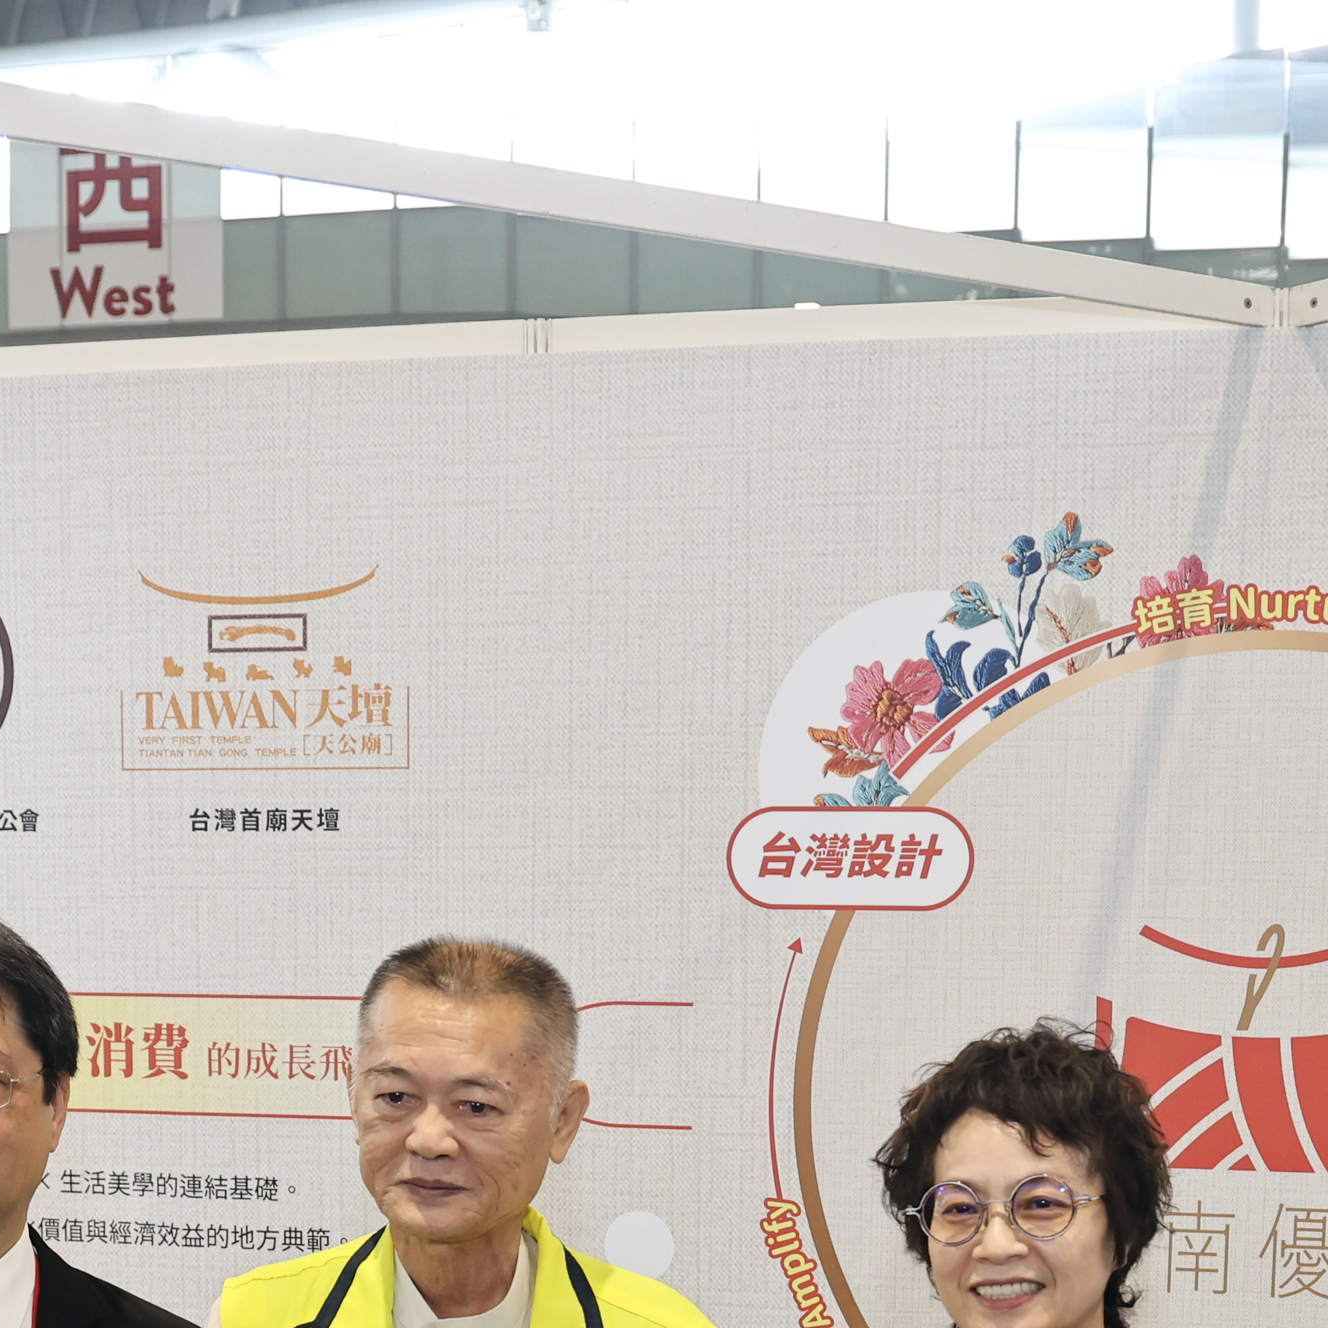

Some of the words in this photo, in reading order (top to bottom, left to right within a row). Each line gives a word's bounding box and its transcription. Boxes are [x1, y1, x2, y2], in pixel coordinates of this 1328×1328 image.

[58, 148, 162, 252] 西
[50, 265, 175, 319] West
[1134, 587, 1215, 636] 培育
[136, 689, 300, 730] TAIWAN
[304, 683, 393, 728] 天壇
[139, 736, 165, 745] VERY
[172, 736, 203, 745] FIRST
[211, 735, 252, 744] TEMPLE
[139, 748, 184, 757] TIANTAN
[188, 748, 212, 757] TIAN
[219, 748, 248, 757] GONG
[257, 748, 297, 757] TEMPLE
[189, 807, 341, 833] 台灣首廟天壇
[758, 831, 944, 880] 台灣設計
[85, 1022, 191, 1081] 消費
[28, 1217, 349, 1253] 價值與經濟效益的地方典範。
